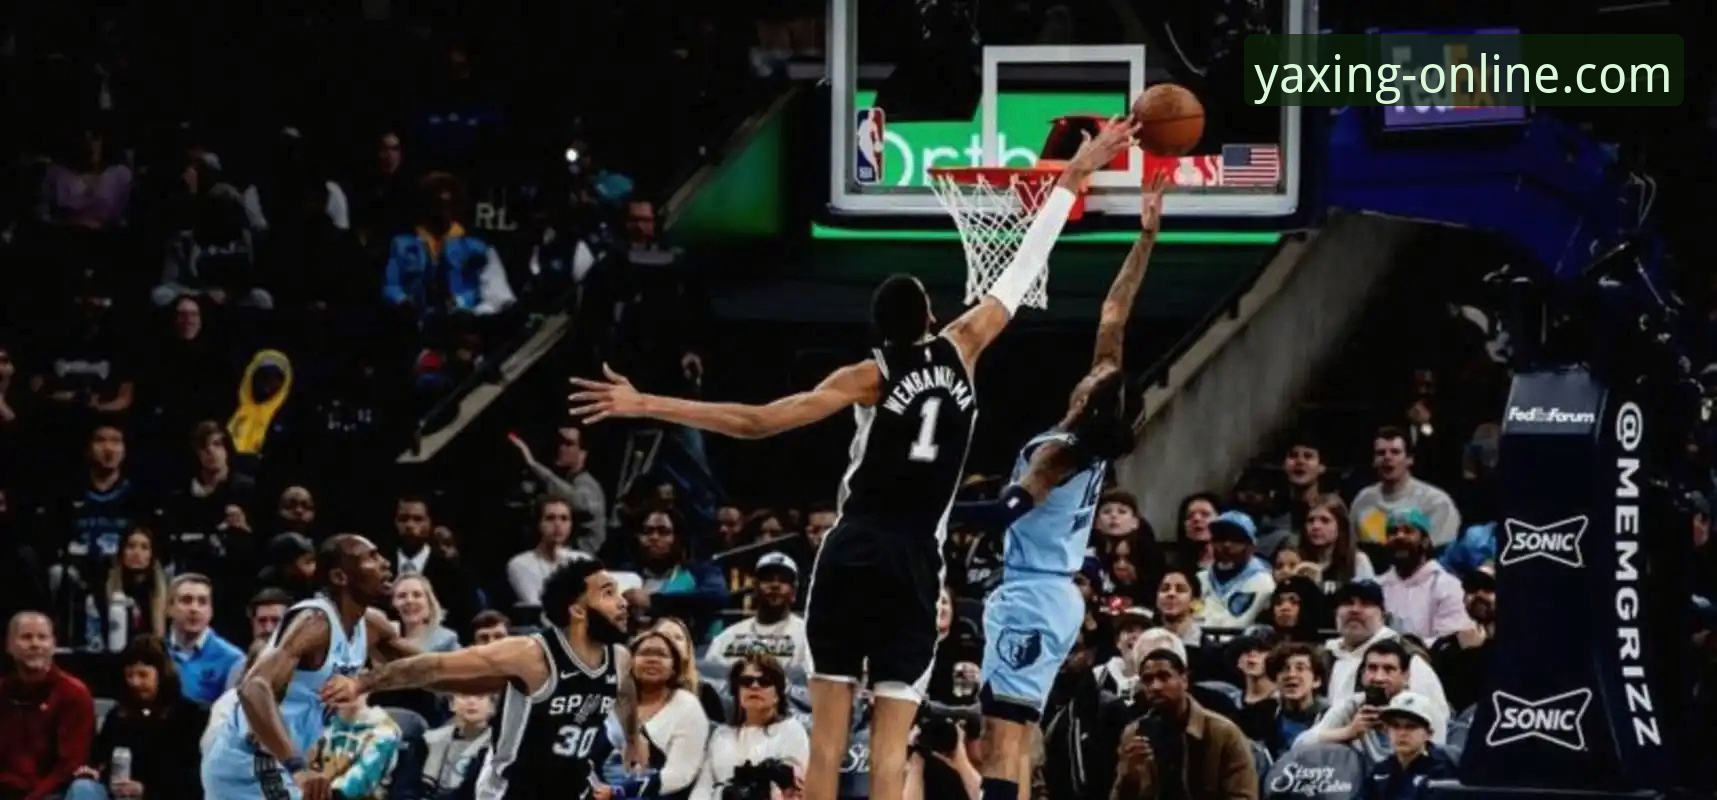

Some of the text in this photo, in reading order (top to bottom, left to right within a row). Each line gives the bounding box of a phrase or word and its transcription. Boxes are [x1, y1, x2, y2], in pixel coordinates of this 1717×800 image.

[882, 365, 974, 416] WEMBANMA
[908, 396, 943, 463] 1
[1511, 531, 1575, 552] SONIC
[1615, 402, 1662, 747] @MEMGRIZZ
[1500, 706, 1577, 732] SONIC
[551, 725, 600, 759] 30
